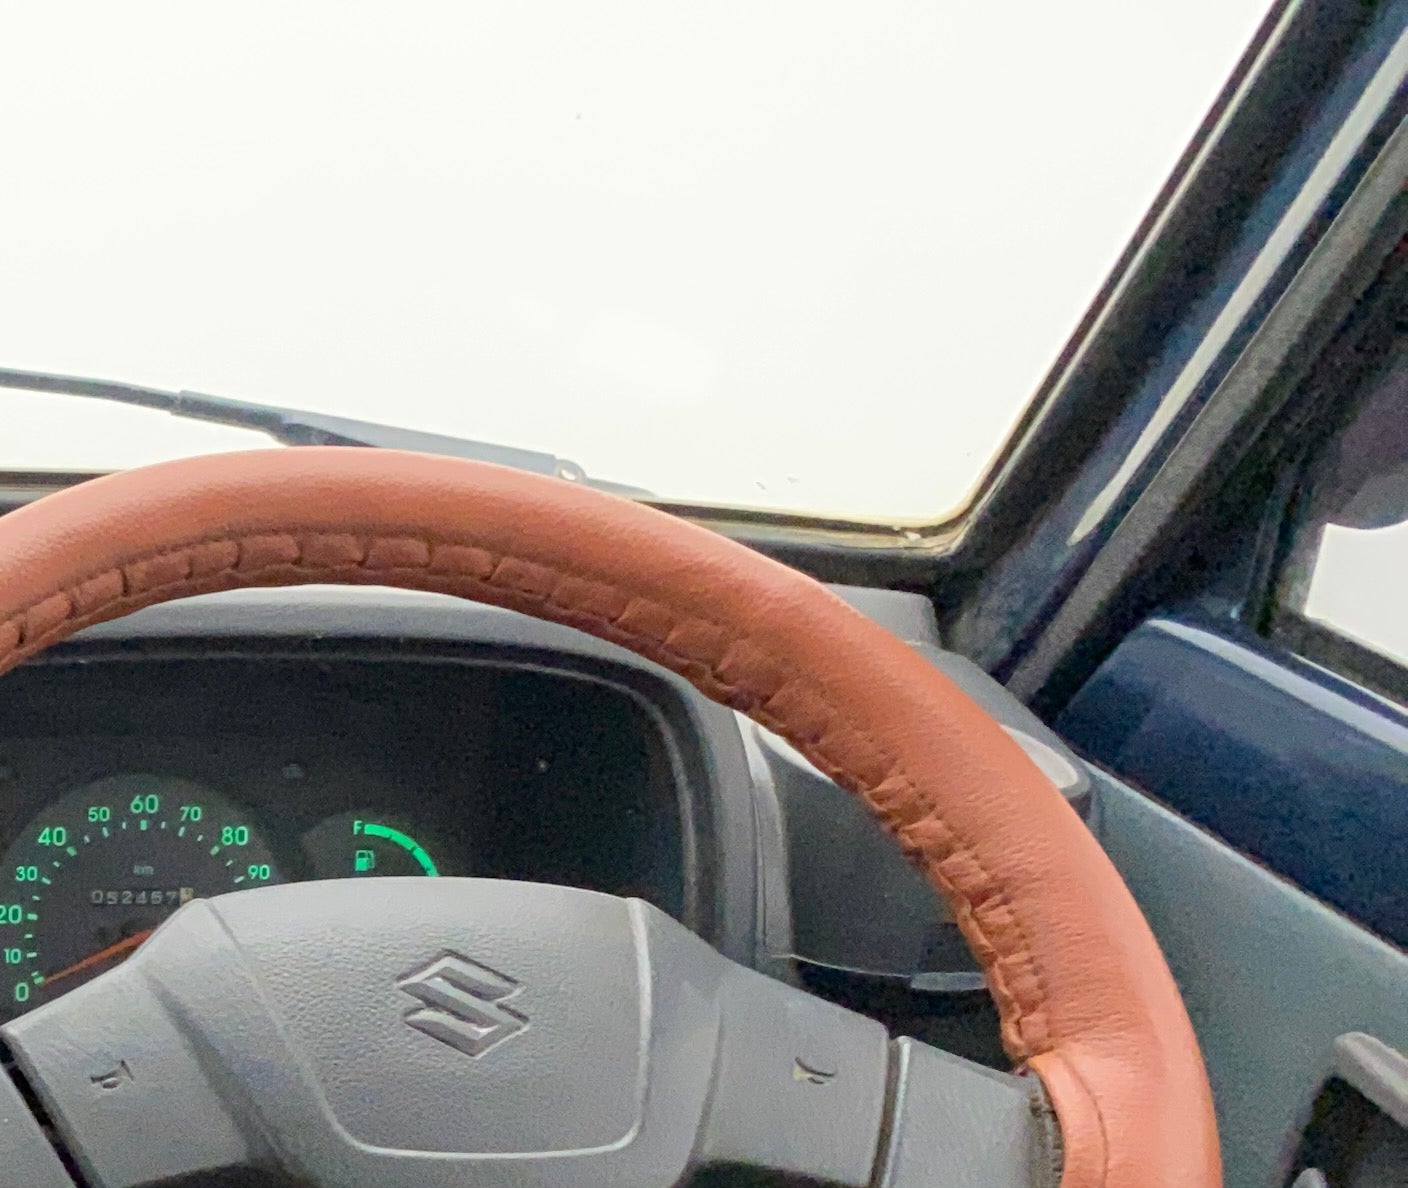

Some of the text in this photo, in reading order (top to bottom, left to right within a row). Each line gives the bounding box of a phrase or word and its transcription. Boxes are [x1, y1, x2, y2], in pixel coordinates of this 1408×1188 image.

[131, 794, 160, 813] 60
[88, 807, 111, 822] 50
[180, 806, 202, 822] 70
[353, 821, 363, 834] F
[38, 827, 68, 846] 40
[220, 826, 250, 847] 80
[16, 865, 39, 882] 30
[133, 863, 155, 875] km
[248, 864, 271, 880] 90
[5, 948, 22, 965] 10
[16, 983, 29, 1002] 0
